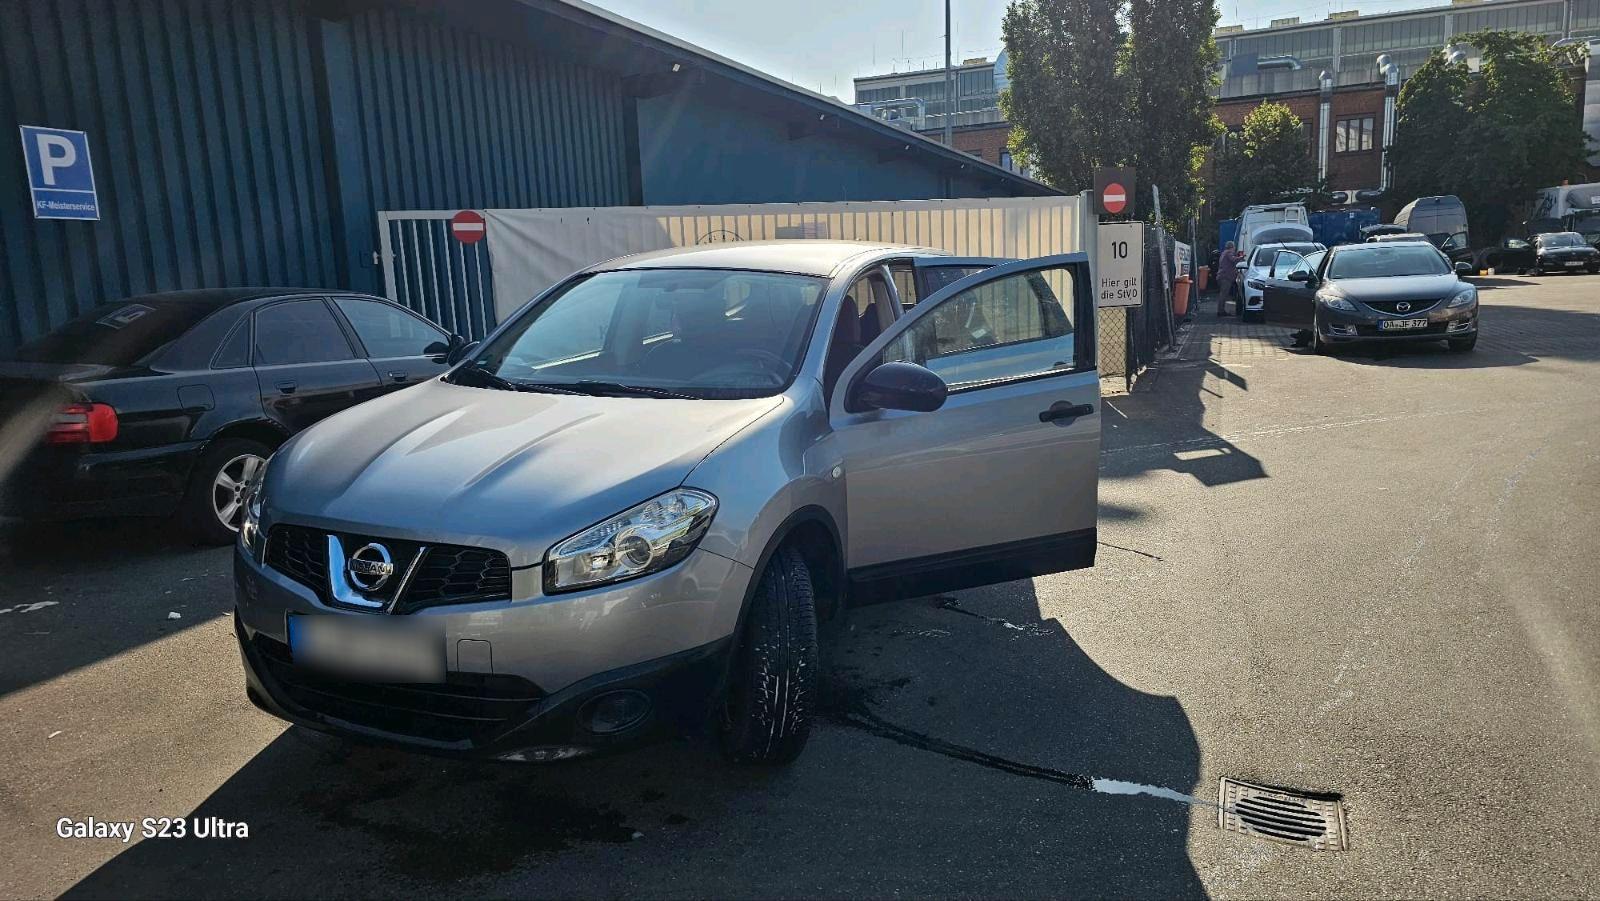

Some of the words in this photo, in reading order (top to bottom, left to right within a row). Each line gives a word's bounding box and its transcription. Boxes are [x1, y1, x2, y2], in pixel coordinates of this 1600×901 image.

[36, 133, 76, 185] P
[1111, 241, 1128, 259] 10
[1101, 278, 1120, 288] Hier
[1124, 277, 1137, 289] gilt
[1101, 290, 1114, 299] die
